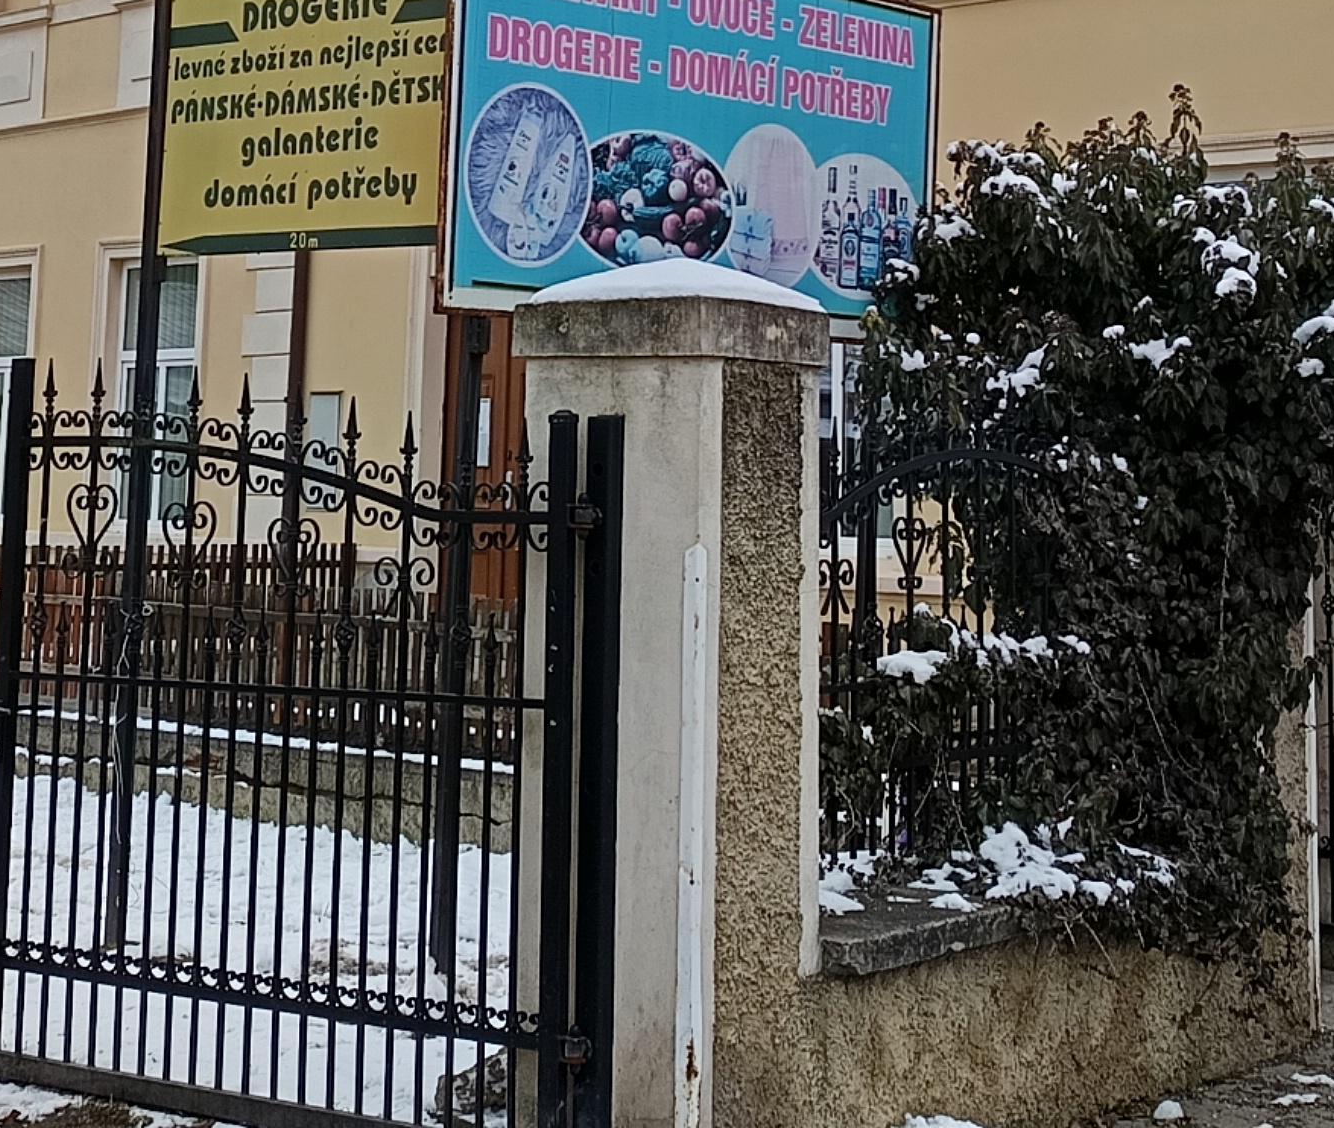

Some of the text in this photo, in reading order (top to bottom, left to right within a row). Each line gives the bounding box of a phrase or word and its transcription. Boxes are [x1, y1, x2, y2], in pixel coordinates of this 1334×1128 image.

[174, 51, 225, 81] levné
[231, 44, 285, 74] zboží
[290, 48, 312, 68] za
[320, 29, 410, 69] nejlepší
[798, 4, 915, 69] ZELENINA
[487, 12, 642, 83] DROGERIE
[668, 45, 779, 107] DOMÁCÍ
[781, 66, 891, 125] POTŘEBY
[242, 116, 379, 166] galanterie
[204, 165, 417, 210] domácí potřeby
[289, 232, 318, 249] 20m
